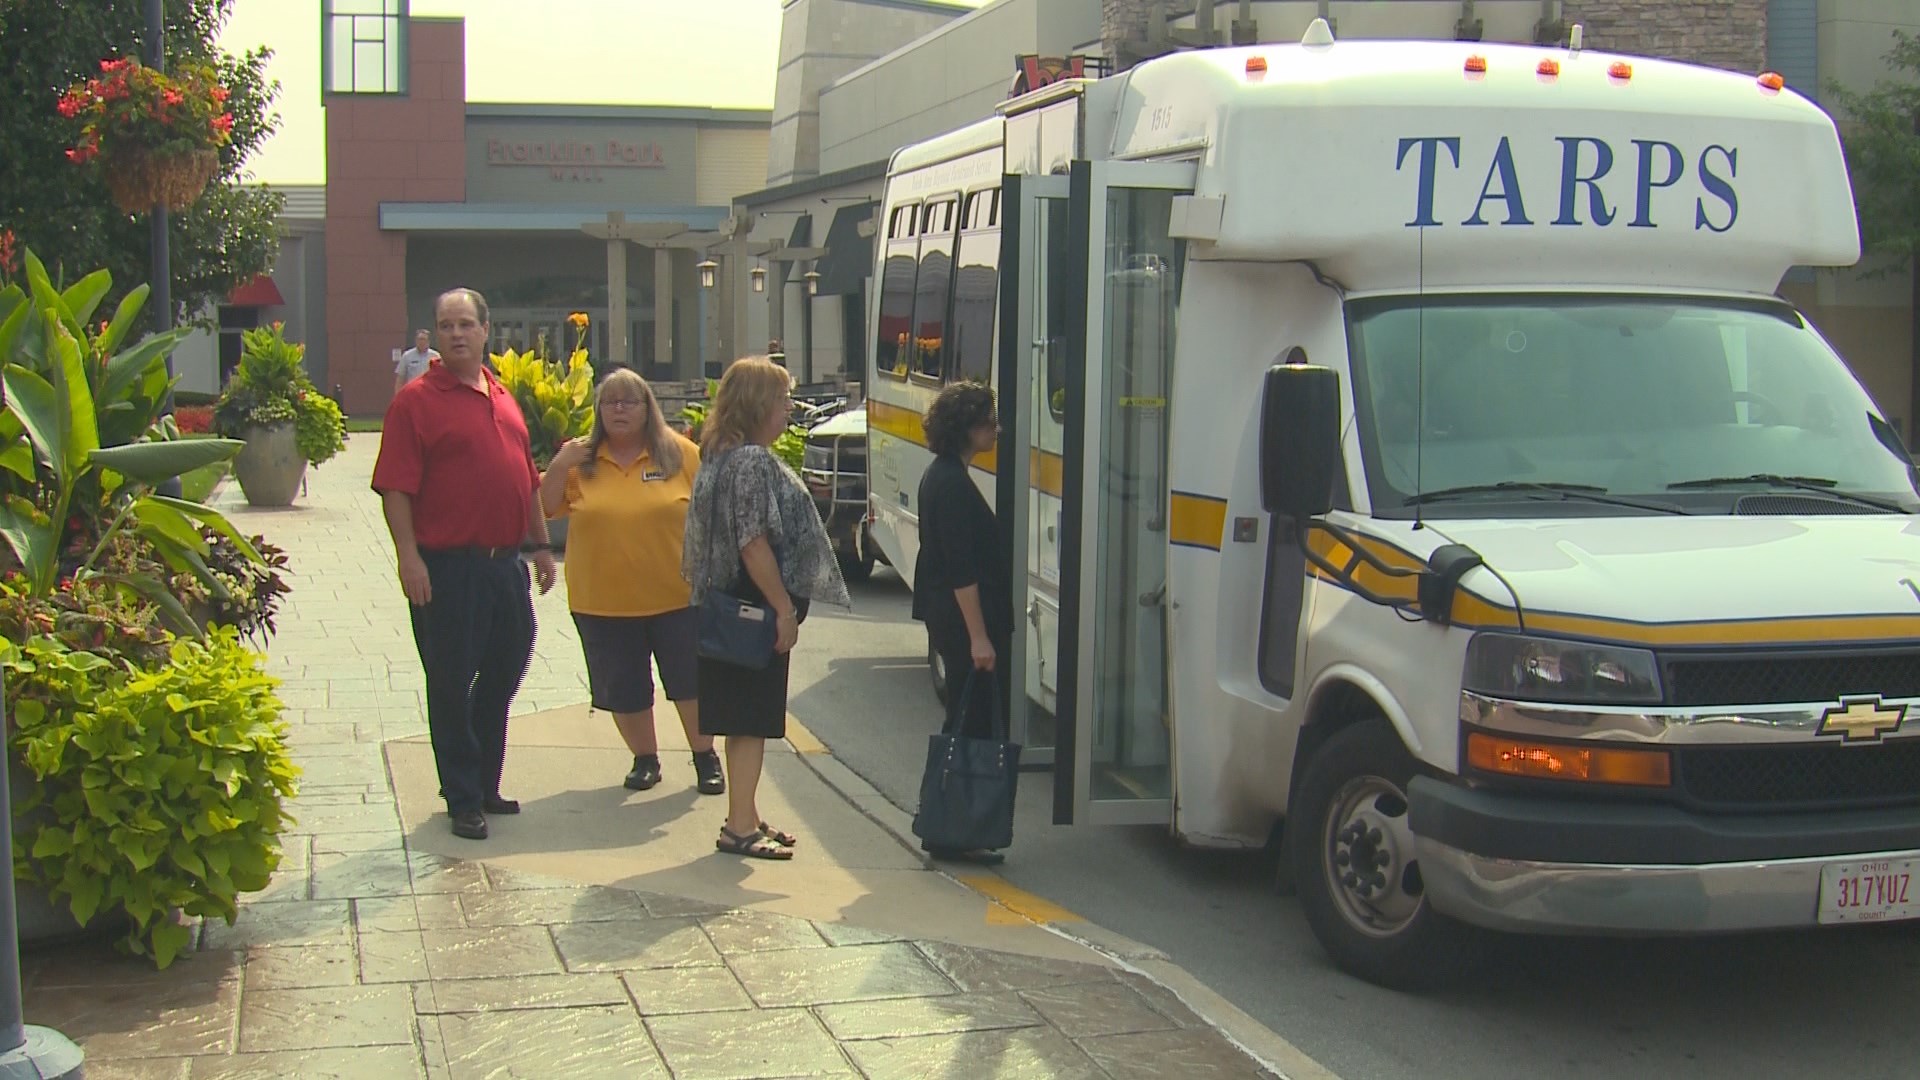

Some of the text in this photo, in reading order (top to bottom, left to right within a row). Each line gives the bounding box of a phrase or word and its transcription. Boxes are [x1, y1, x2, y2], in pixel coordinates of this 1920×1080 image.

[1151, 105, 1173, 131] 1515
[487, 137, 664, 163] Franklin Park
[1396, 136, 1738, 232] TARPS
[1861, 863, 1889, 873] OHIO
[1838, 874, 1910, 908] 317YUZ
[1858, 911, 1887, 920] COUNTY
